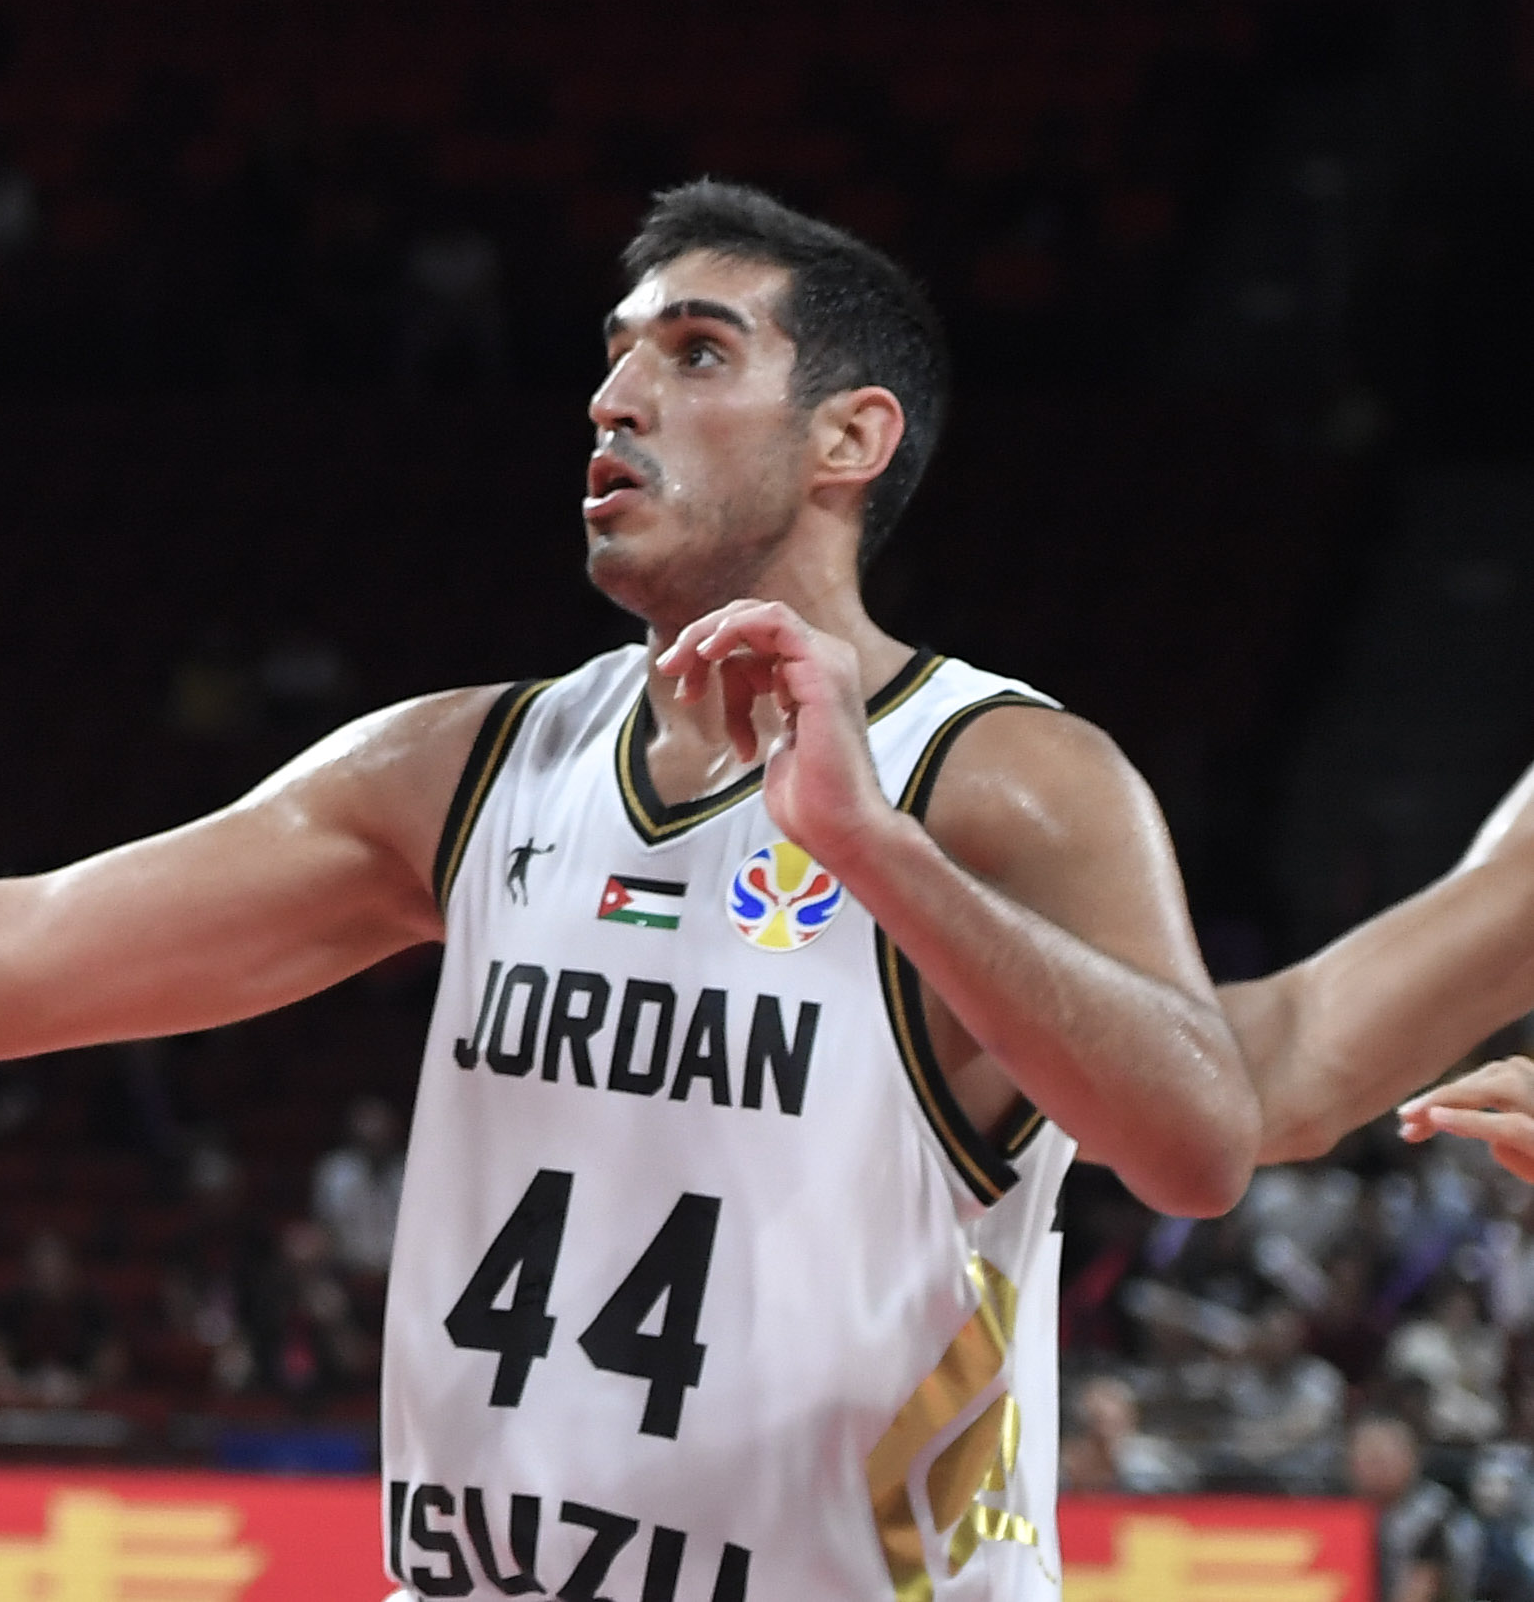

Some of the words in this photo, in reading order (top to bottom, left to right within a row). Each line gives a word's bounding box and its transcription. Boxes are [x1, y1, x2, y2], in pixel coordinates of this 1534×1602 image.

[454, 959, 821, 1116] JORDAN
[443, 1168, 722, 1440] 44
[391, 1481, 752, 1602] ISUZU
